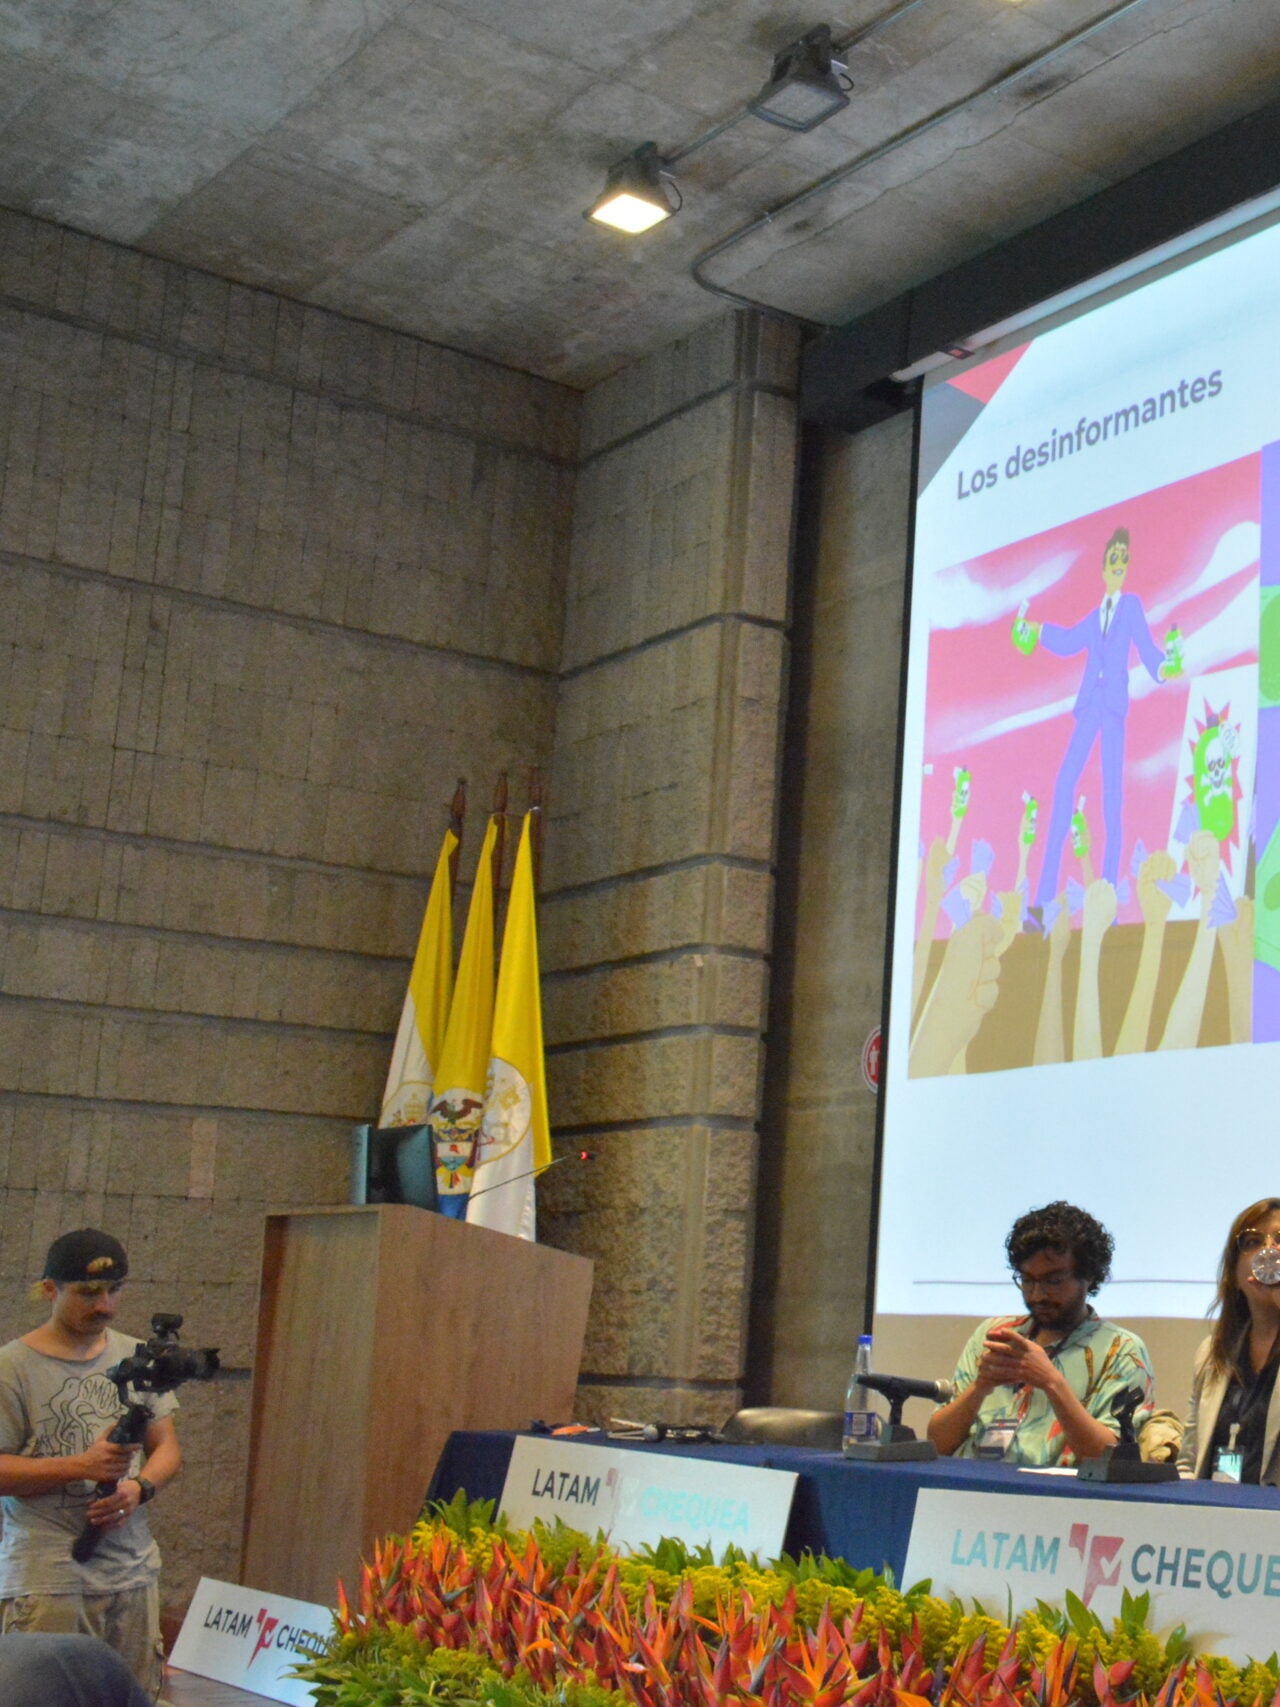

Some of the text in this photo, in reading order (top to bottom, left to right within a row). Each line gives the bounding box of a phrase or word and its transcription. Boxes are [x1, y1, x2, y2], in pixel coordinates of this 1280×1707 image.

[957, 369, 1223, 500] Los desinformantes
[531, 1468, 750, 1533] LATAM CHEQUEA
[950, 1529, 1061, 1576] LATAM
[203, 1604, 254, 1638] LATAM
